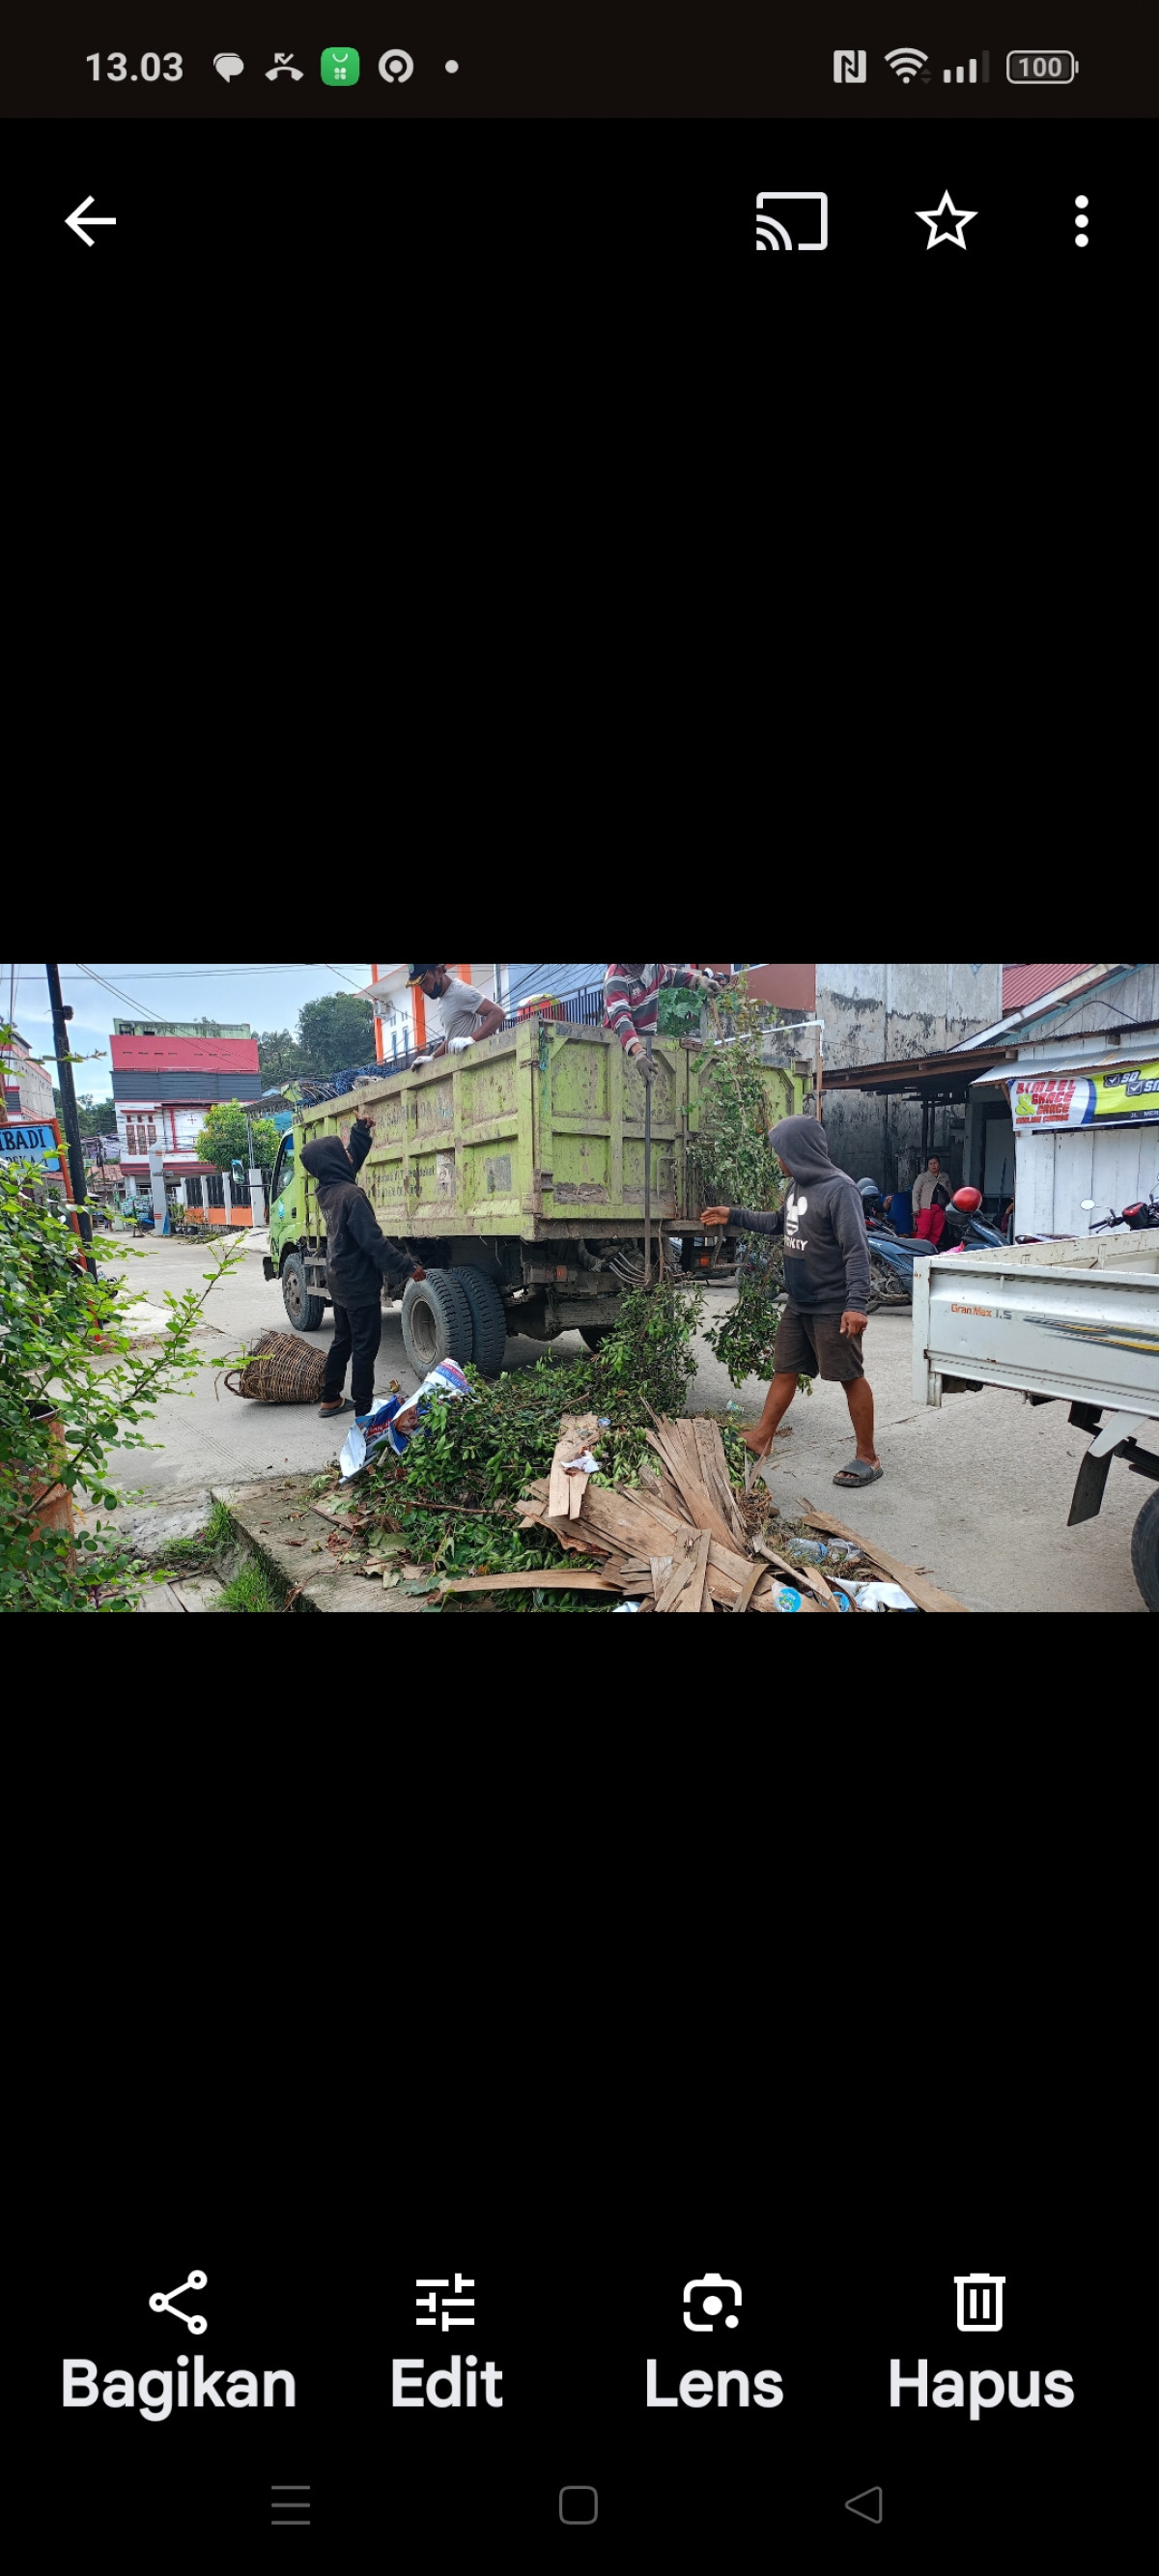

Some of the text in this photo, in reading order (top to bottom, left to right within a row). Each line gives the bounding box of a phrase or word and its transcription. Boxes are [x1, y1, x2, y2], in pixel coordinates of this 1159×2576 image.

[87, 52, 1062, 81] 13.03 100
[1016, 1079, 1077, 1094] BIMBEL
[62, 2354, 1075, 2422] Bagikan Edit Lens Hapus
